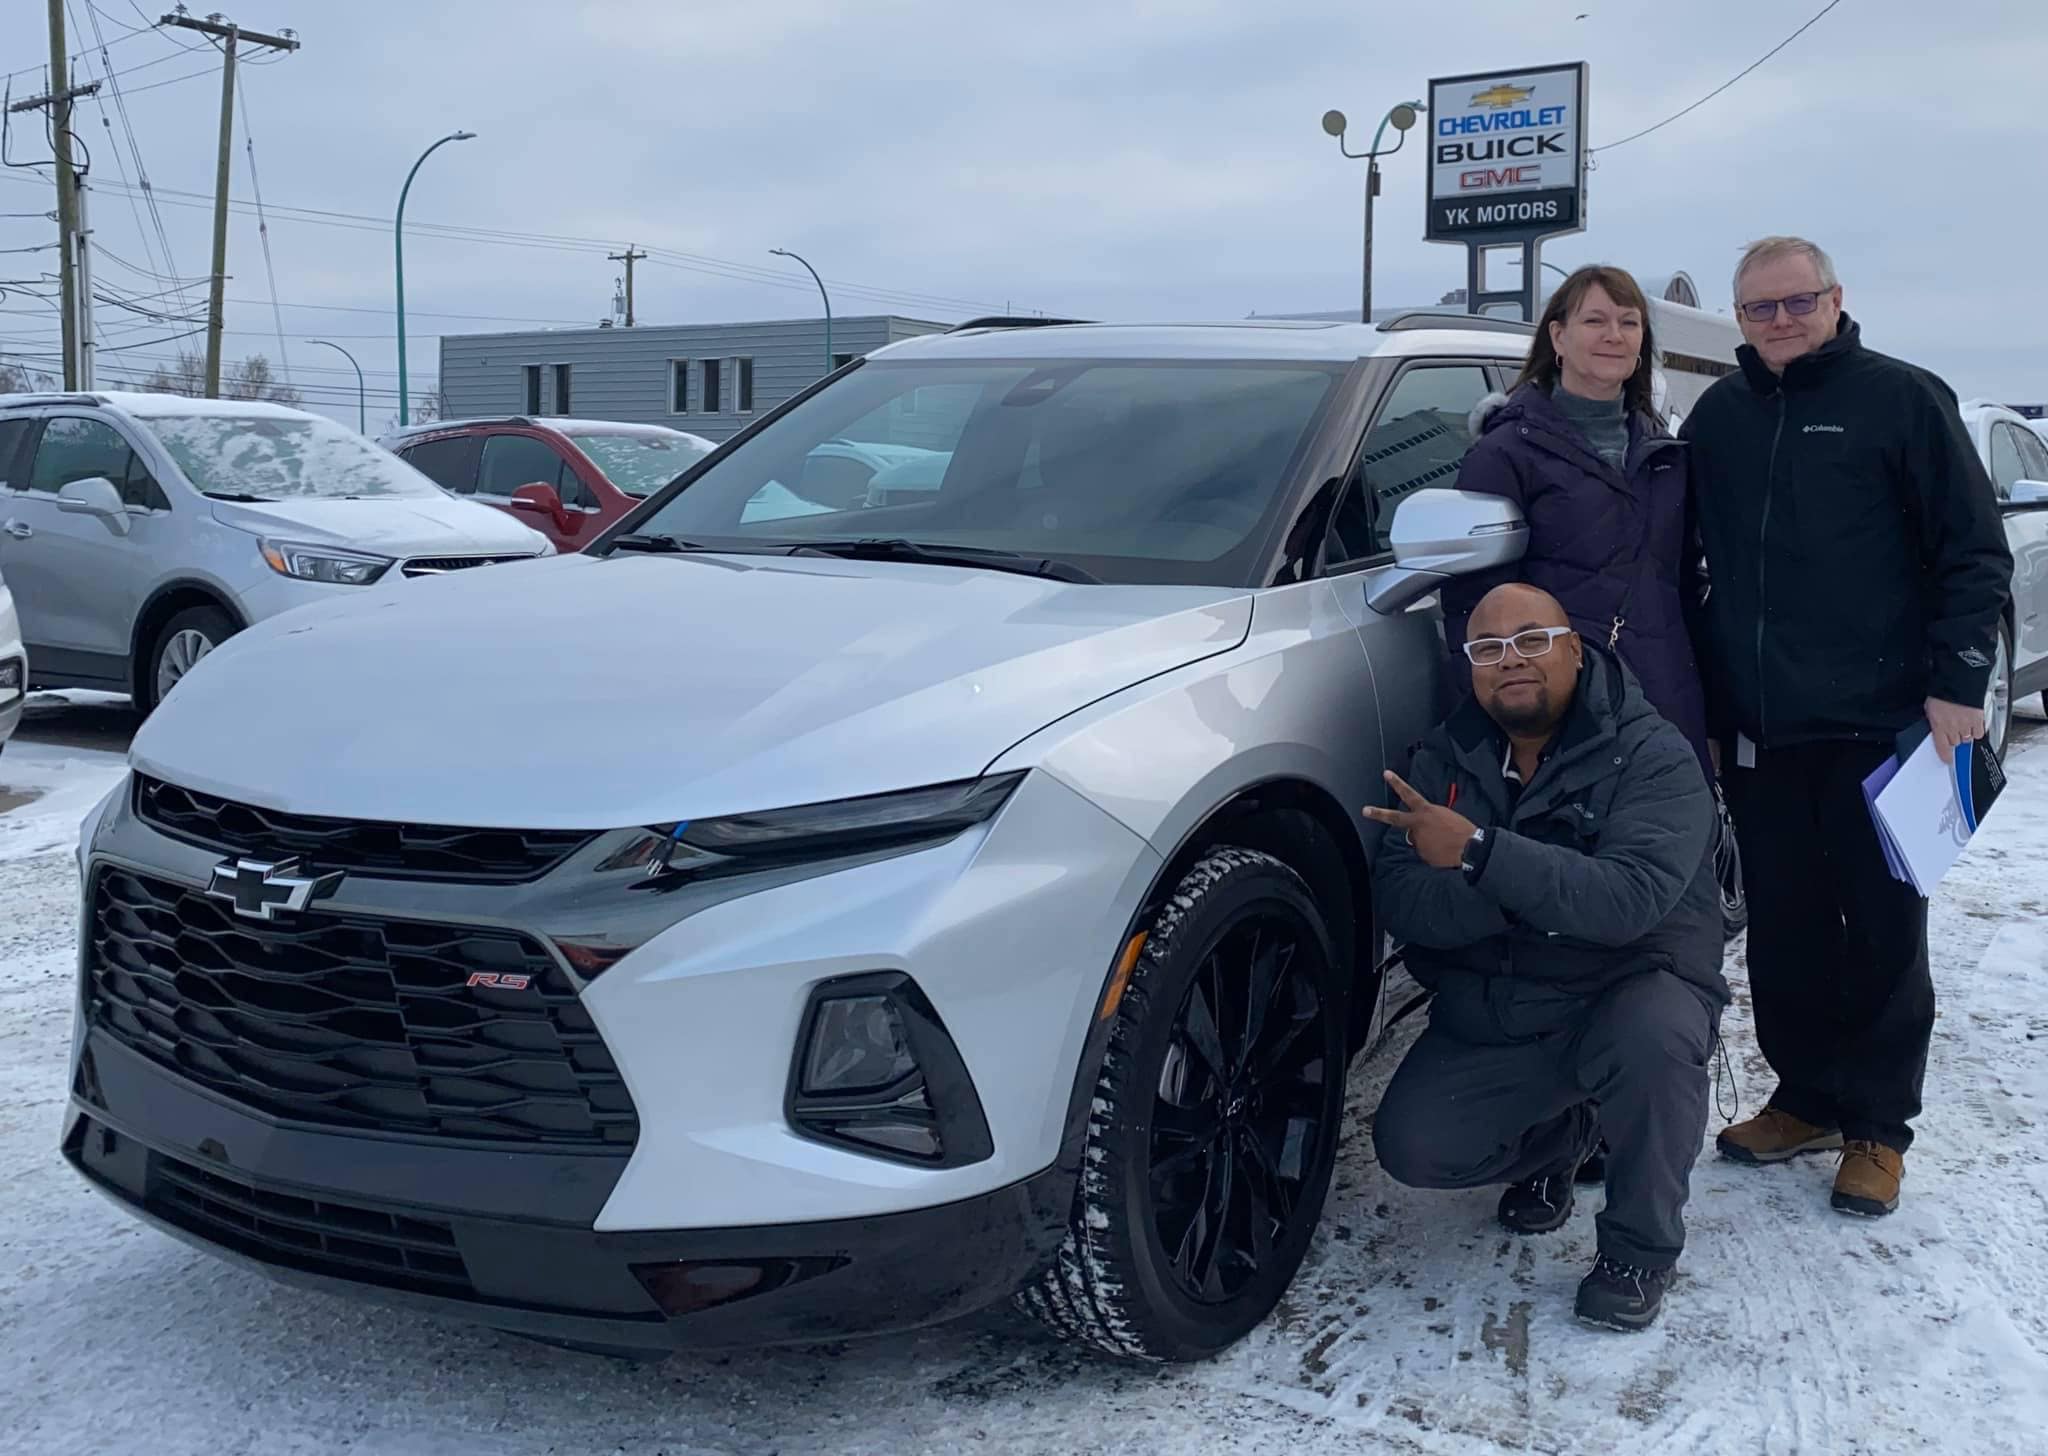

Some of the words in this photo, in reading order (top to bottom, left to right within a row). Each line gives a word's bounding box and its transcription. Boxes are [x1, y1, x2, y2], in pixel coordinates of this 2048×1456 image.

[1439, 106, 1566, 137] CHEVROLET
[1437, 132, 1566, 164] BUICK
[1460, 164, 1541, 190] GMC
[1445, 207, 1470, 225] YK
[1477, 200, 1558, 223] MOTORS
[466, 972, 531, 990] RS
